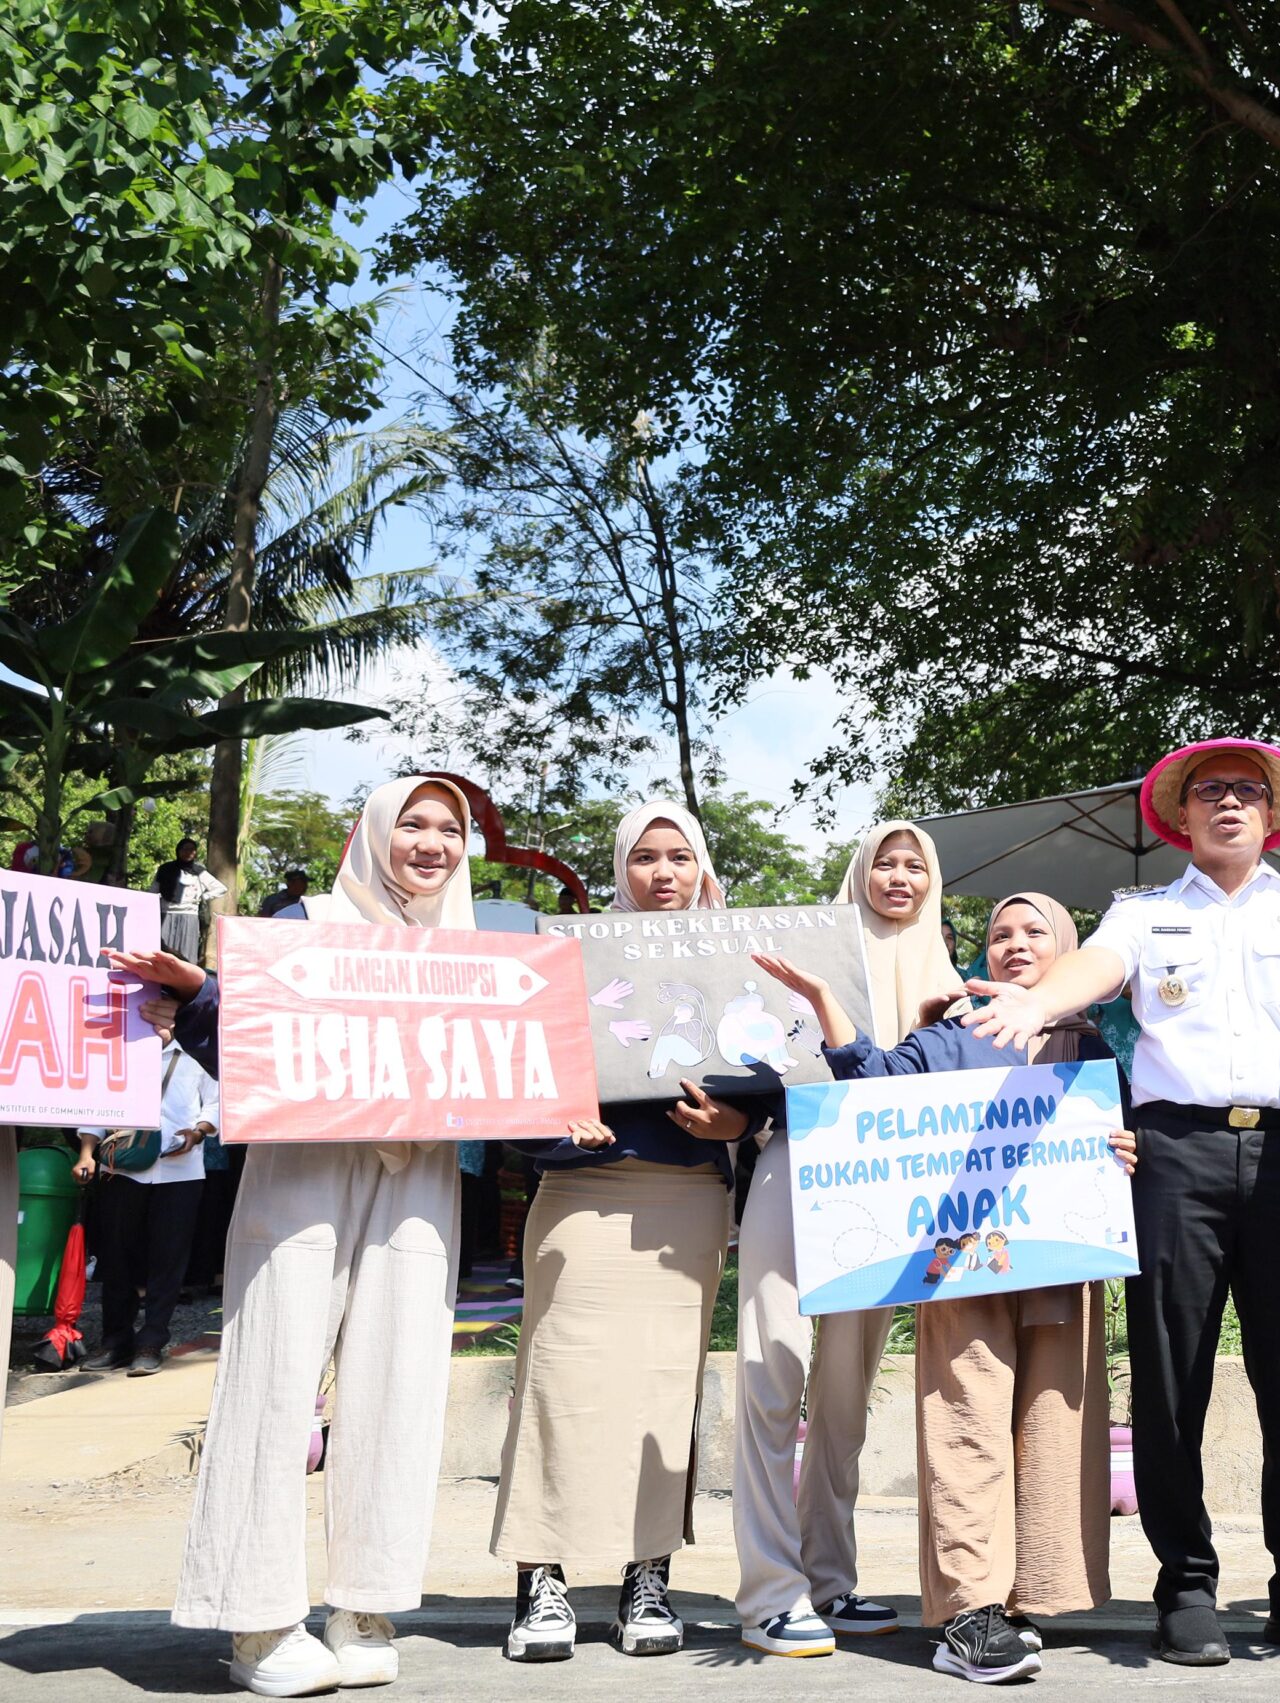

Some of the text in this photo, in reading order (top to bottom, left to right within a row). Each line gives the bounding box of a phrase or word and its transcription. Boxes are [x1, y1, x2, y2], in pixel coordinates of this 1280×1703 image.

[547, 910, 838, 939] STOP KEKERASAN
[624, 935, 782, 960] SEKSUAL
[329, 956, 498, 997] JANGAN KORUPSI
[266, 1013, 559, 1102] USIA SAYA
[39, 1106, 48, 1114] OF
[50, 1107, 94, 1117] COMMUNITY
[96, 1109, 125, 1118] JUSTICE
[856, 1094, 1057, 1143] PELAMINAN
[799, 1135, 1117, 1190] BUKAN TEMPAT BERMAIN
[907, 1184, 1030, 1237] ANAK
